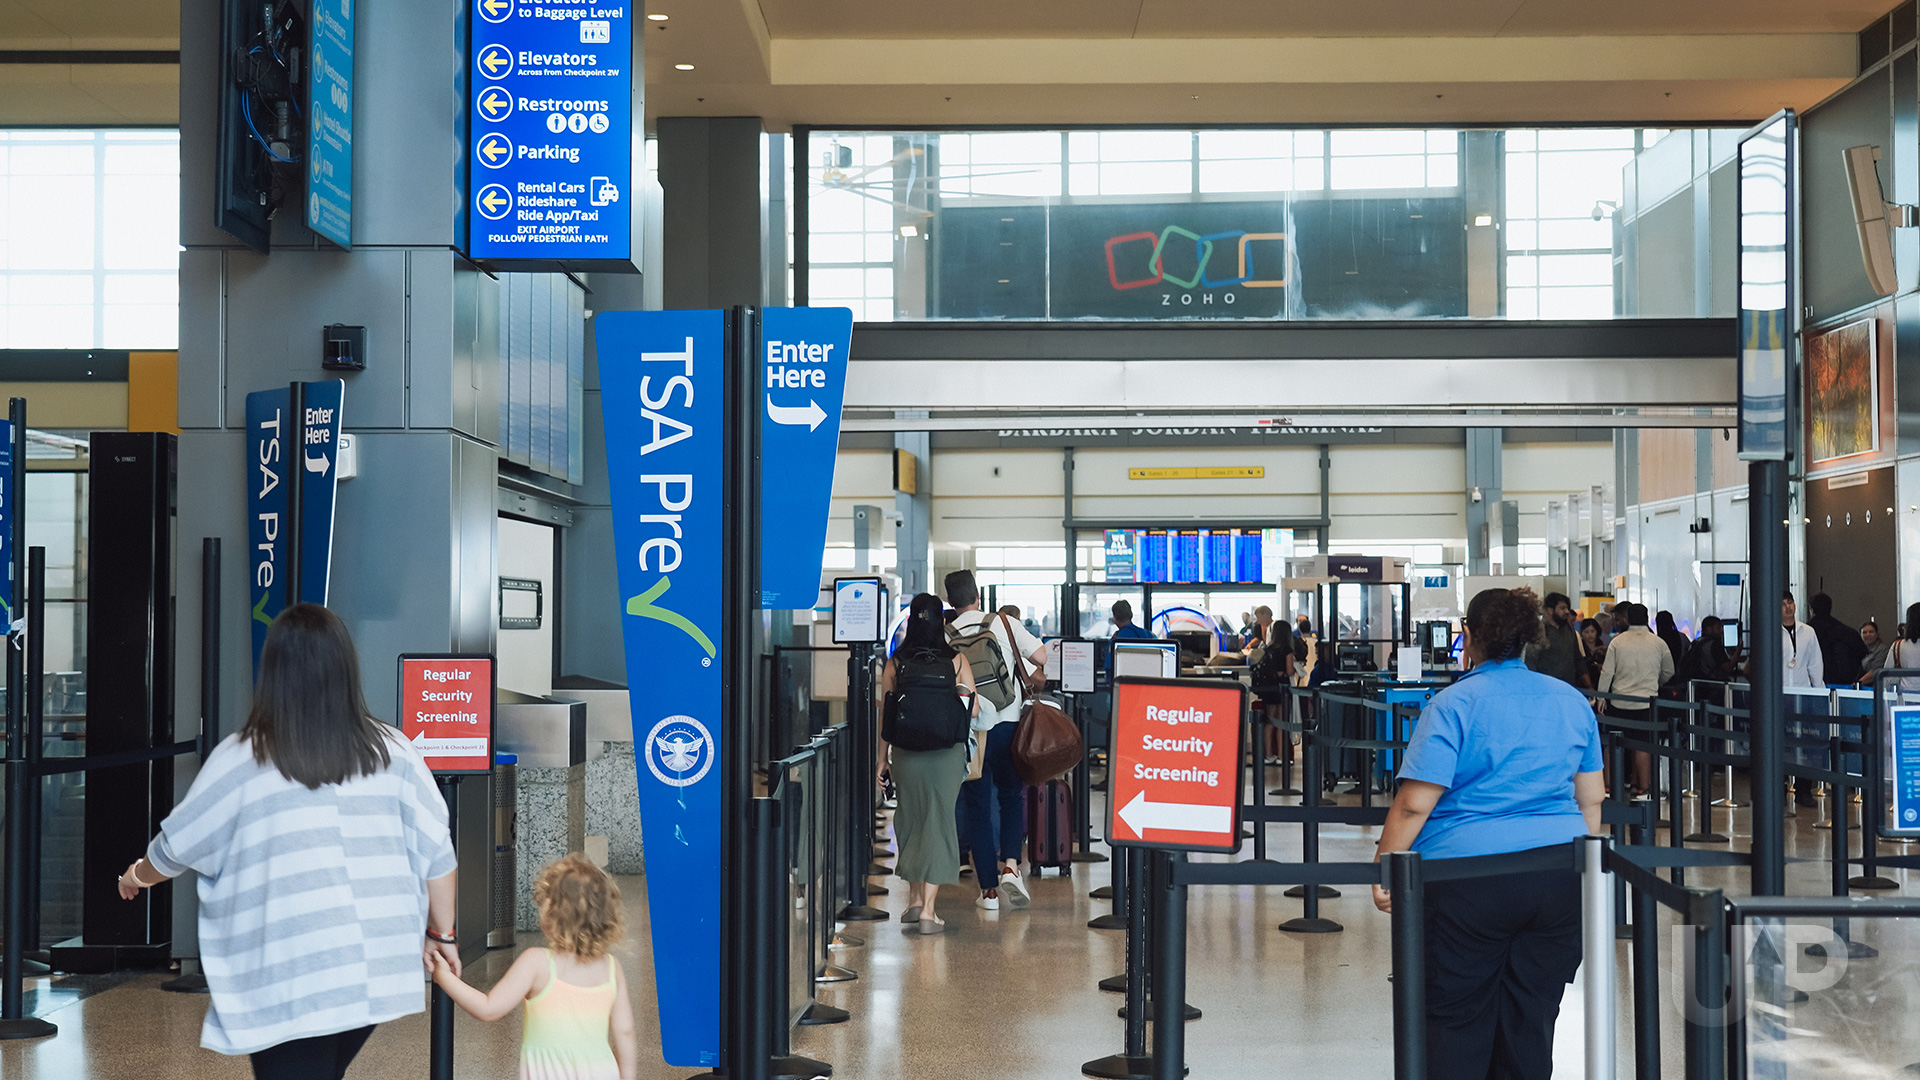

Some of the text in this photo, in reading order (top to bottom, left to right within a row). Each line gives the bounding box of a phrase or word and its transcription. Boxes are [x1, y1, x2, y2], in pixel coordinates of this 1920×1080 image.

[518, 7, 623, 21] to Baggage Level
[518, 51, 597, 66] Elevators
[518, 69, 620, 78] Across from Checkpoint 2W
[518, 97, 609, 112] Restrooms
[518, 145, 580, 163] Parking
[517, 182, 586, 193] Rental Cars
[517, 196, 577, 207] Rideshare
[517, 210, 599, 223] Ride App/Taxi
[517, 225, 580, 234] EXIT AIRPORT
[488, 234, 609, 243] FOLLOW PEDESTRIAN PATH
[1162, 293, 1236, 305] ZOHO
[766, 340, 834, 363] Enter
[766, 365, 826, 388] Here
[639, 336, 694, 456] TSA
[305, 407, 334, 426] Enter
[305, 427, 330, 445] Here
[259, 408, 280, 500] TSA
[1348, 566, 1368, 574] leidos
[423, 668, 472, 683] Regular
[421, 690, 473, 704] Security
[416, 710, 478, 725] Screening
[1146, 705, 1213, 725] Regular
[1142, 734, 1213, 757] Security
[1133, 763, 1219, 787] Screening
